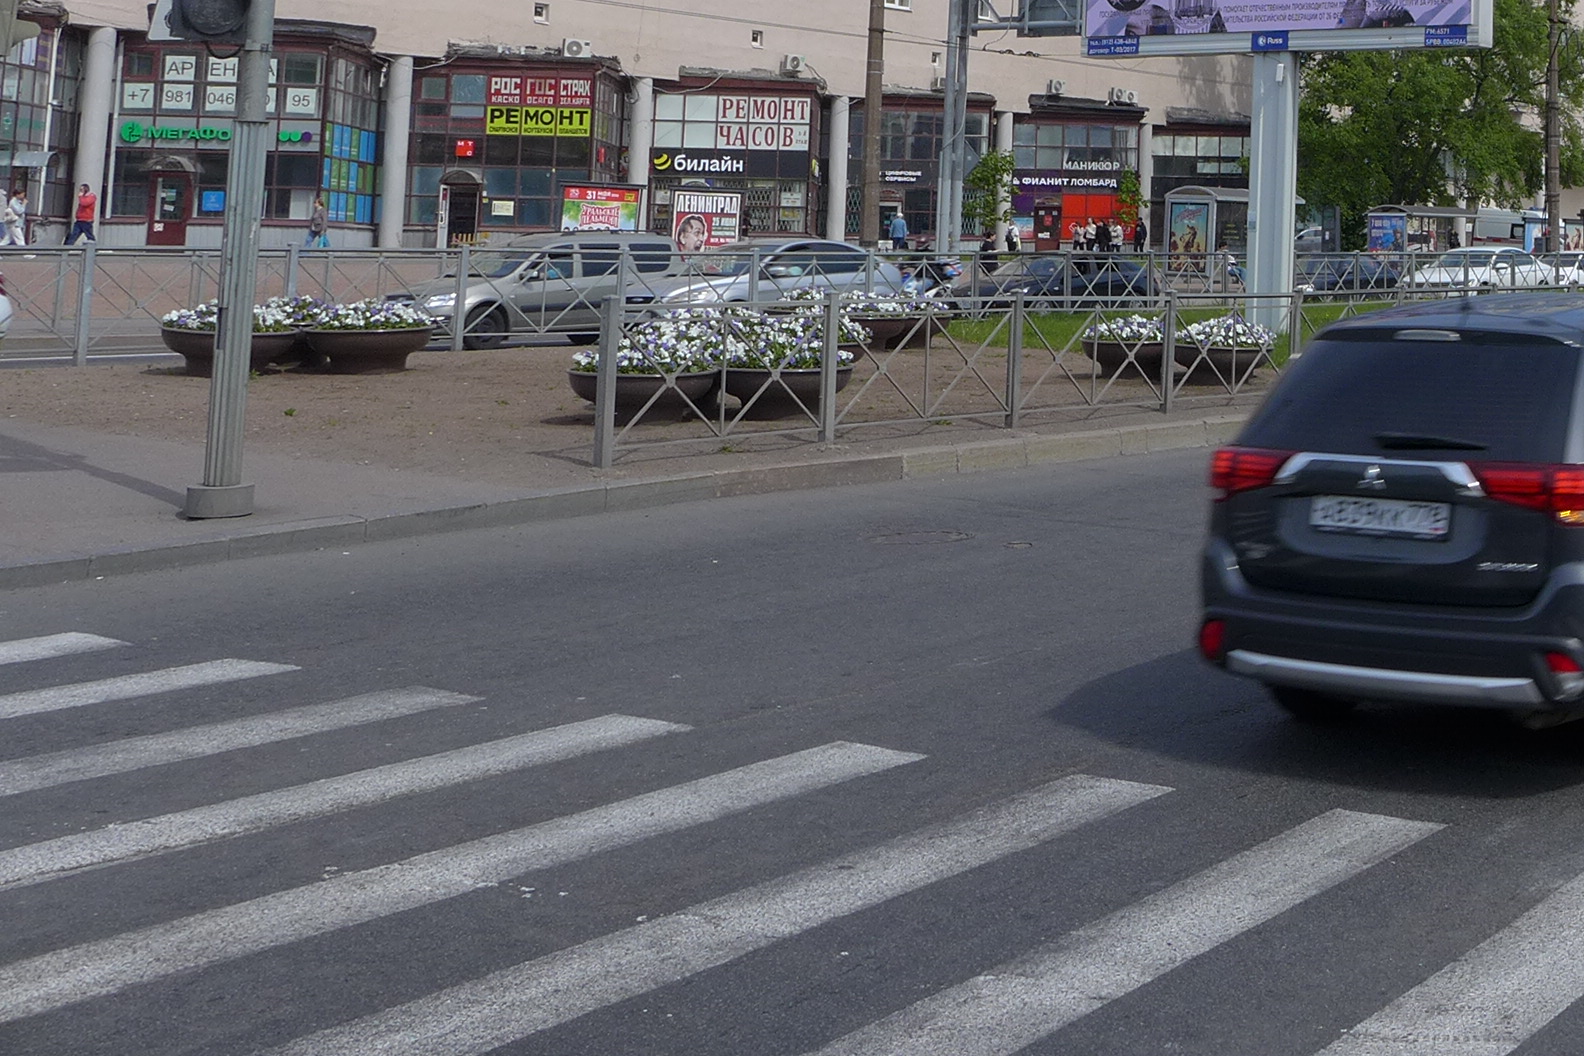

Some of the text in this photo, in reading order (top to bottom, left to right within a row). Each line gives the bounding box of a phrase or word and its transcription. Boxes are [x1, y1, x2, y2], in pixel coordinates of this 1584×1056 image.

[1267, 37, 1283, 45] Russ
[128, 88, 310, 107] +7 981 046 95
[490, 108, 588, 126] РЕМОНТ
[722, 98, 808, 120] РЕМОНТ
[149, 126, 232, 141] МЕГАФО
[719, 125, 793, 147] ЧАСОВ
[674, 155, 743, 172] билайн
[1063, 160, 1120, 171] МАНИКЮР
[1022, 176, 1117, 189] ФИАНИТ ЛОМБАРД
[677, 194, 738, 214] ЛЕНИНГРАД
